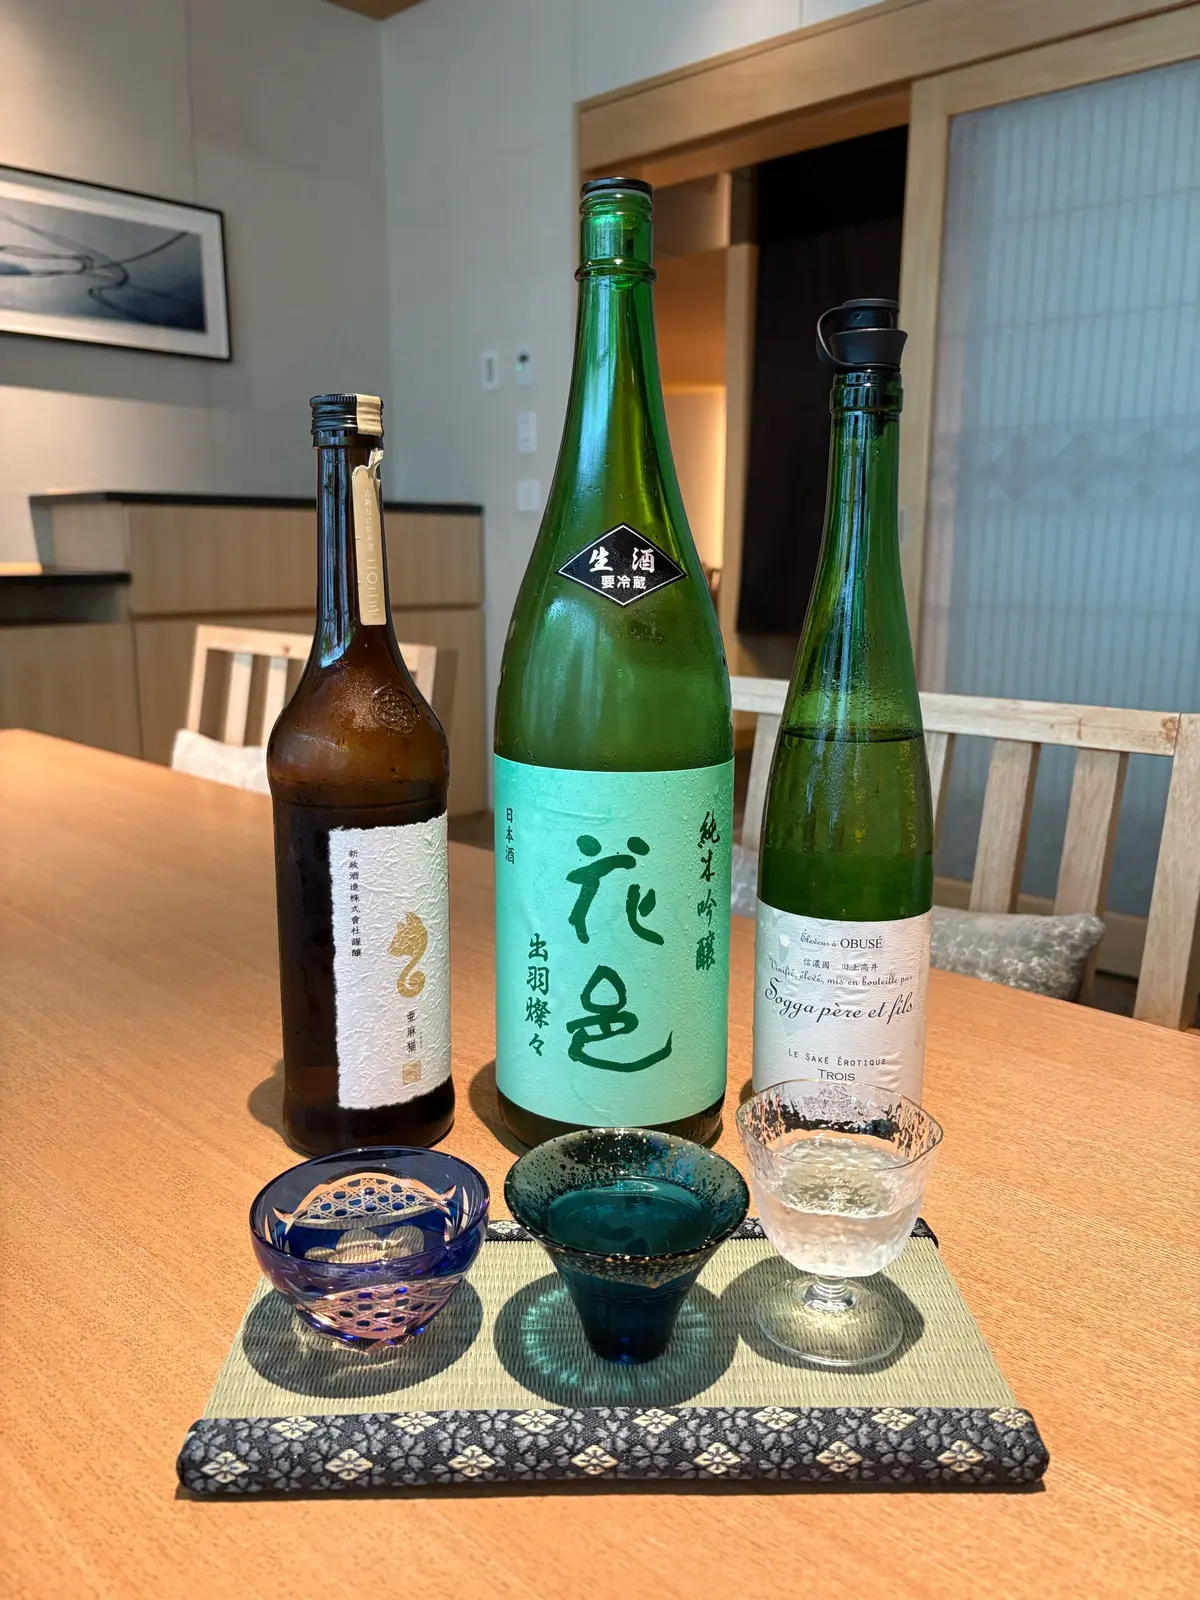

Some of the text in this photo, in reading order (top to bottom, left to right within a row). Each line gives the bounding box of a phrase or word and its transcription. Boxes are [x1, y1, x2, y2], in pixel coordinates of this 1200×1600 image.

[589, 546, 655, 573] 生酒
[601, 575, 647, 590] 要冷蔵
[505, 807, 515, 865] 日本酒
[565, 834, 673, 1073] 花邑
[800, 929, 830, 947] Éleveur
[840, 936, 883, 949] OBUSÉ
[524, 933, 552, 1057] 出羽燦々
[827, 976, 844, 986] mis
[862, 973, 898, 987] bouteille
[764, 976, 915, 1025] Sogga père et fils
